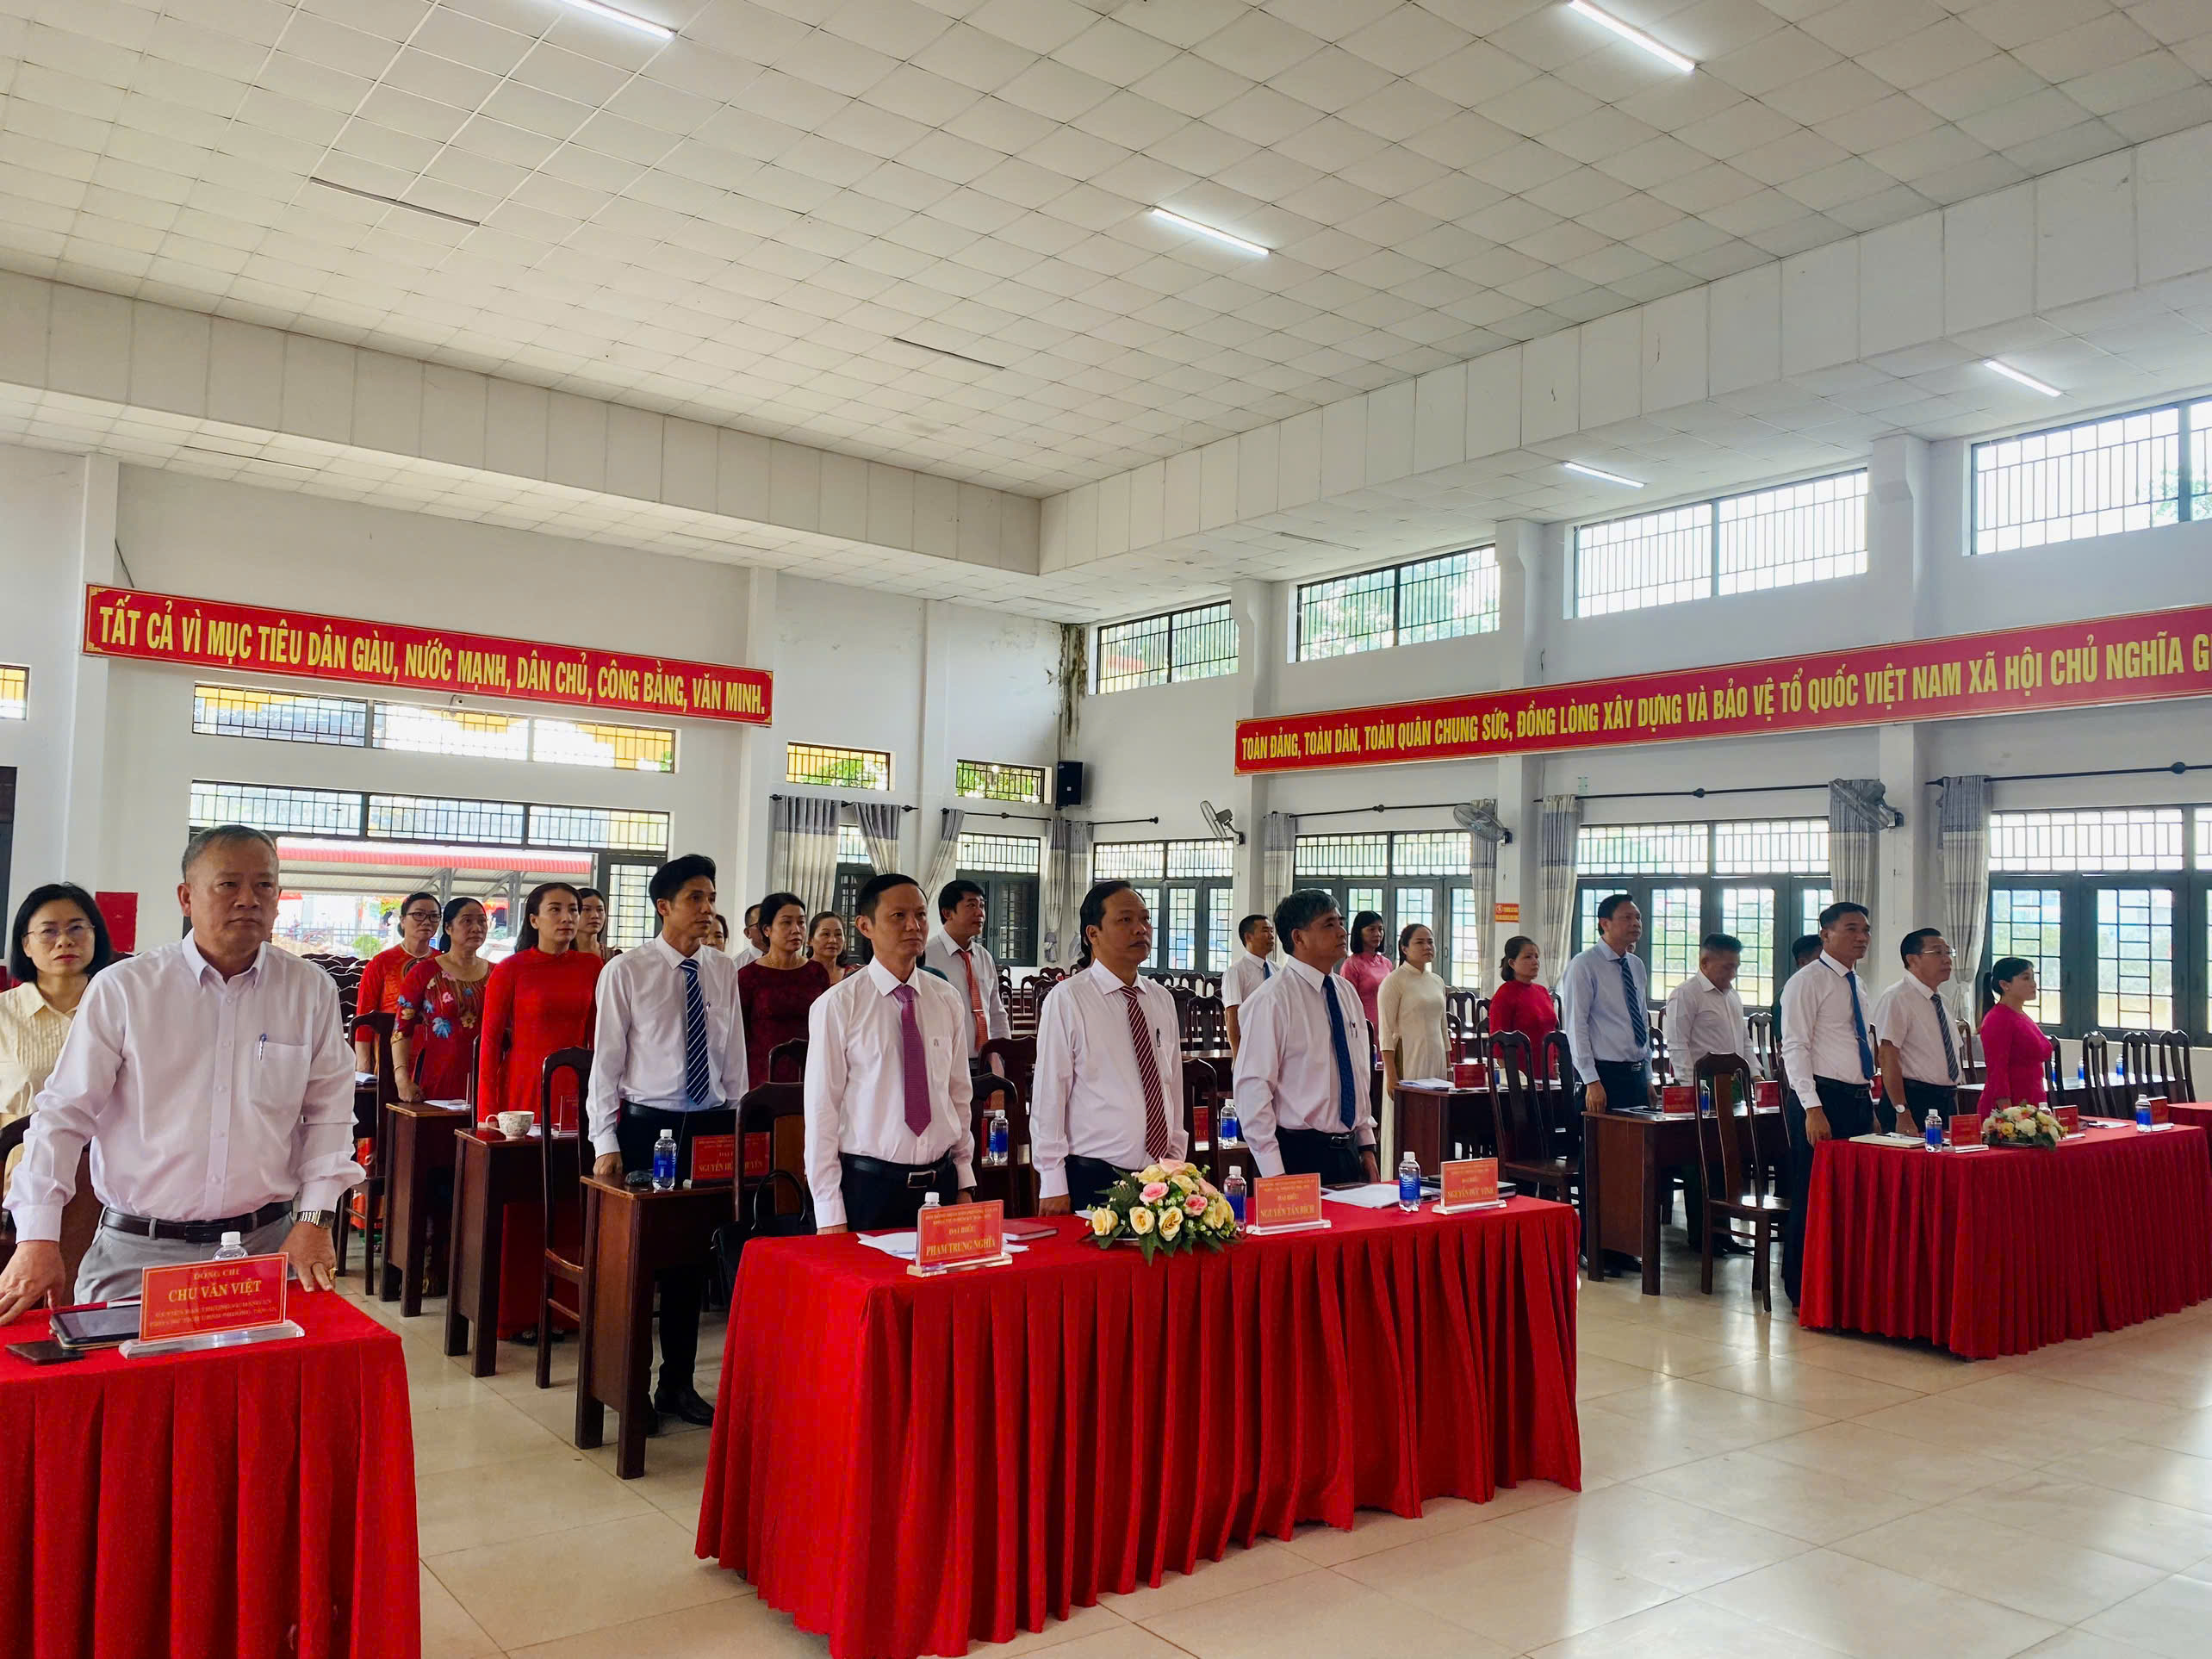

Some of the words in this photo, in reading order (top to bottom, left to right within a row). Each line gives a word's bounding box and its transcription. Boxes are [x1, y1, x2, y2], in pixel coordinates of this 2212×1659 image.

[99, 595, 141, 646] TẤT
[146, 600, 173, 651] CẢ
[182, 609, 201, 654] VÌ
[207, 620, 252, 665] MỤC
[258, 619, 302, 665] TIÊU
[307, 624, 346, 670] DÂN
[351, 631, 400, 682] GIÀU,
[405, 637, 453, 681] NƯỚC
[457, 649, 511, 694] MẠNH,
[517, 650, 551, 691] DÂN
[555, 651, 593, 703] CHỦ,
[597, 659, 639, 702] CÔNG
[643, 660, 687, 713] BẰNG,
[692, 673, 721, 710] VĂN
[725, 681, 766, 714] MINH.
[1242, 734, 1267, 761] TOÀN
[1270, 726, 1302, 759] ĐẢNG,
[1304, 727, 1333, 756] TOÀN
[1335, 724, 1361, 755] DÂN,
[1364, 720, 1395, 749] TOÀN
[1397, 716, 1432, 748] QUÂN
[1434, 716, 1479, 745] CHUNG
[1482, 707, 1513, 743] SỨC,
[1516, 700, 1556, 738] ĐỒNG
[1559, 699, 1599, 734] LÒNG
[1602, 694, 1634, 730] XÂY
[1637, 693, 1682, 732] DỰNG
[1687, 685, 1709, 722] VÀ
[1712, 677, 1749, 720] BẢO
[1753, 676, 1774, 722] VỆ
[1780, 668, 1804, 713] TỔ
[1807, 663, 1859, 714] QUỐC
[1864, 662, 1907, 711] VIỆT
[1912, 661, 1961, 700] NAM
[1968, 650, 1998, 694] XÃ
[2004, 646, 2043, 697] HỘI
[2050, 634, 2098, 687] CHỦ
[2105, 631, 2184, 681] NGHĨA
[232, 1277, 262, 1297] VIỆT
